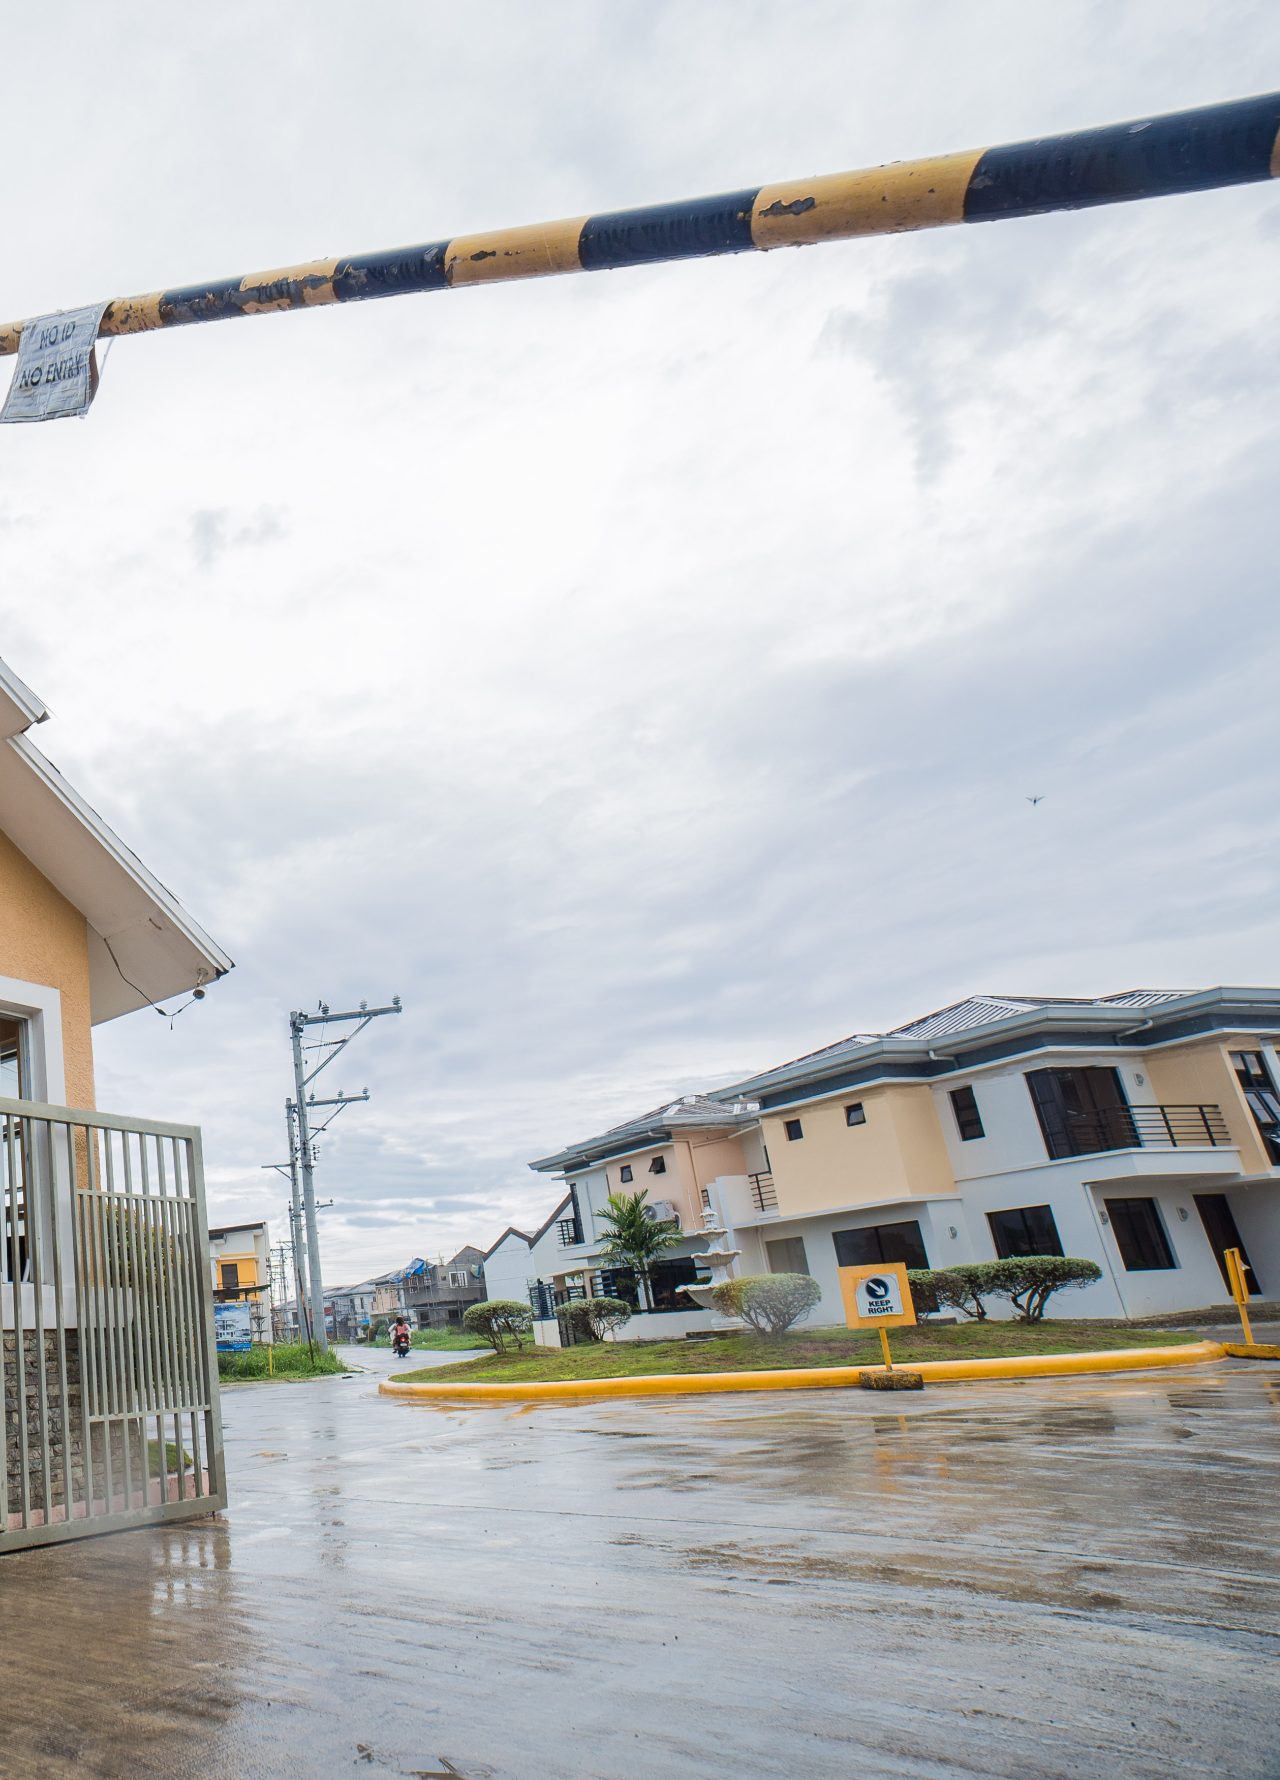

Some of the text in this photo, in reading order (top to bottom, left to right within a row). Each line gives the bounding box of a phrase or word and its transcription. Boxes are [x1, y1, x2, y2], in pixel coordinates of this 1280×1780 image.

[40, 321, 77, 349] NO ID
[19, 353, 82, 389] NO ENTRY
[868, 1299, 891, 1308] KEEP
[868, 1306, 894, 1314] RIGHT
